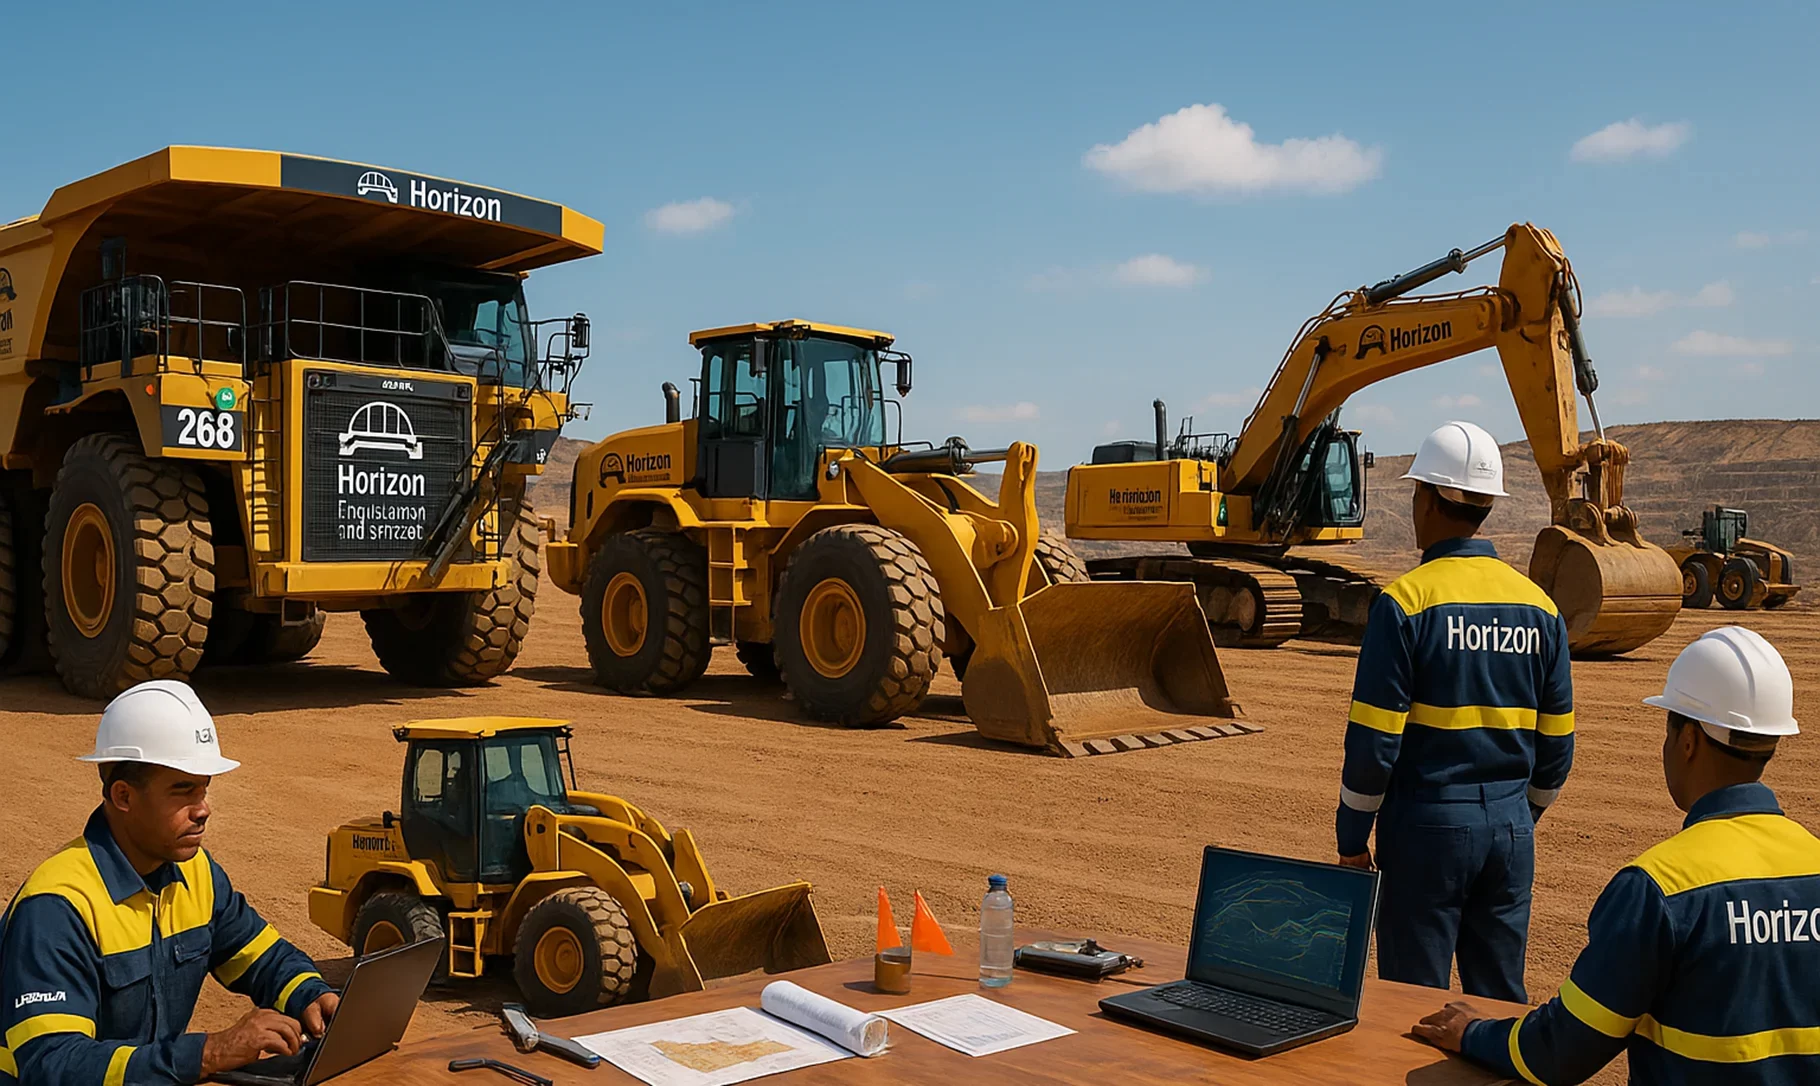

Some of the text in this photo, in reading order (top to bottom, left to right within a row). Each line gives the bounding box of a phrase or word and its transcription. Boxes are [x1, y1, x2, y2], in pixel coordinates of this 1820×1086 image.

[410, 179, 501, 222] Horizon
[1390, 321, 1452, 352] Horizon
[177, 408, 234, 449] 268
[338, 464, 425, 496] Horizon
[626, 453, 671, 473] Horizon
[1447, 615, 1540, 655] Horizon
